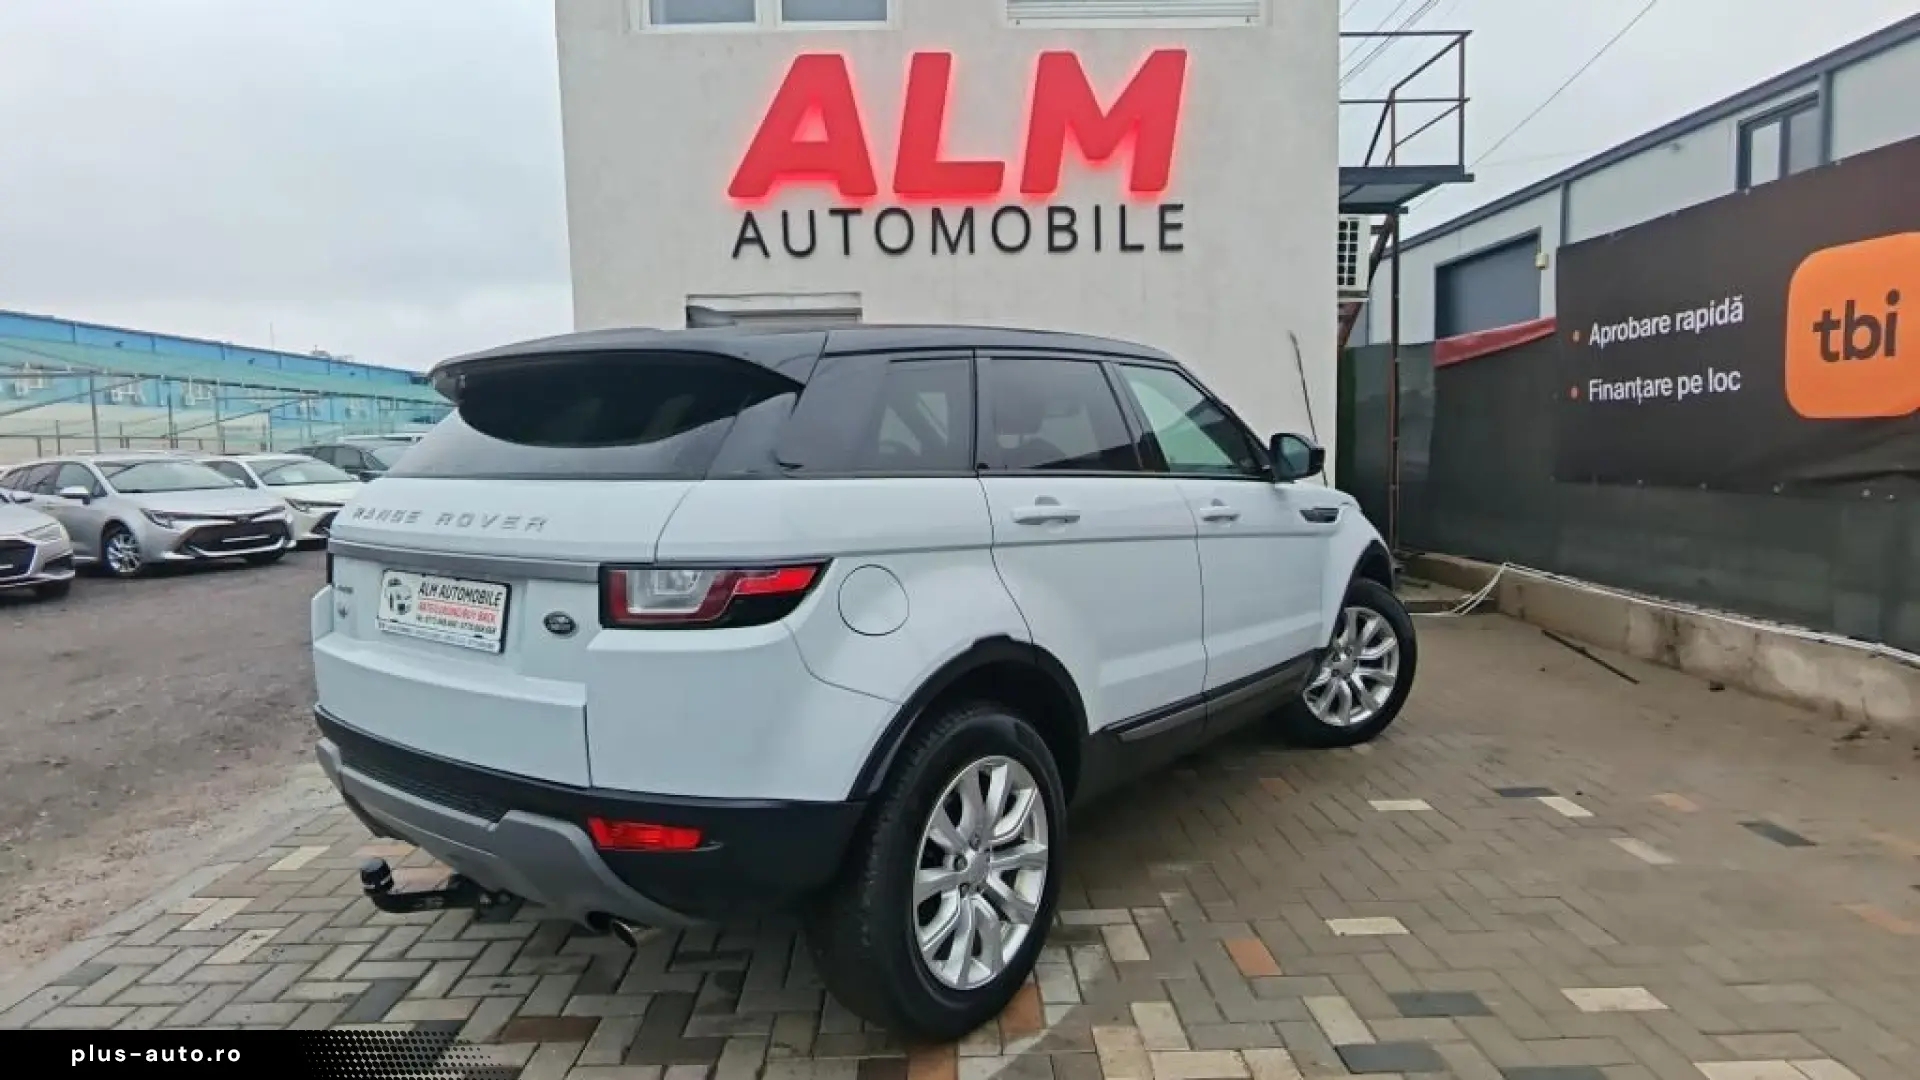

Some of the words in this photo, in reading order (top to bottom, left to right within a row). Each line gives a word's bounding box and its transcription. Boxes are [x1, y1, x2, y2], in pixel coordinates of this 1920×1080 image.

[728, 49, 1188, 198] ALM
[732, 203, 1186, 259] AUTOMOBILE
[1588, 313, 1671, 349] Aprobare
[1674, 294, 1744, 334] rapidă
[1812, 288, 1900, 363] tbi
[1589, 376, 1674, 405] Finanțare
[1677, 374, 1703, 401] pe
[1707, 366, 1742, 393] loc
[351, 506, 423, 526] RANGE
[434, 510, 550, 533] ROVER
[418, 581, 439, 598] ALM
[438, 584, 503, 608] AUTOMOBILE
